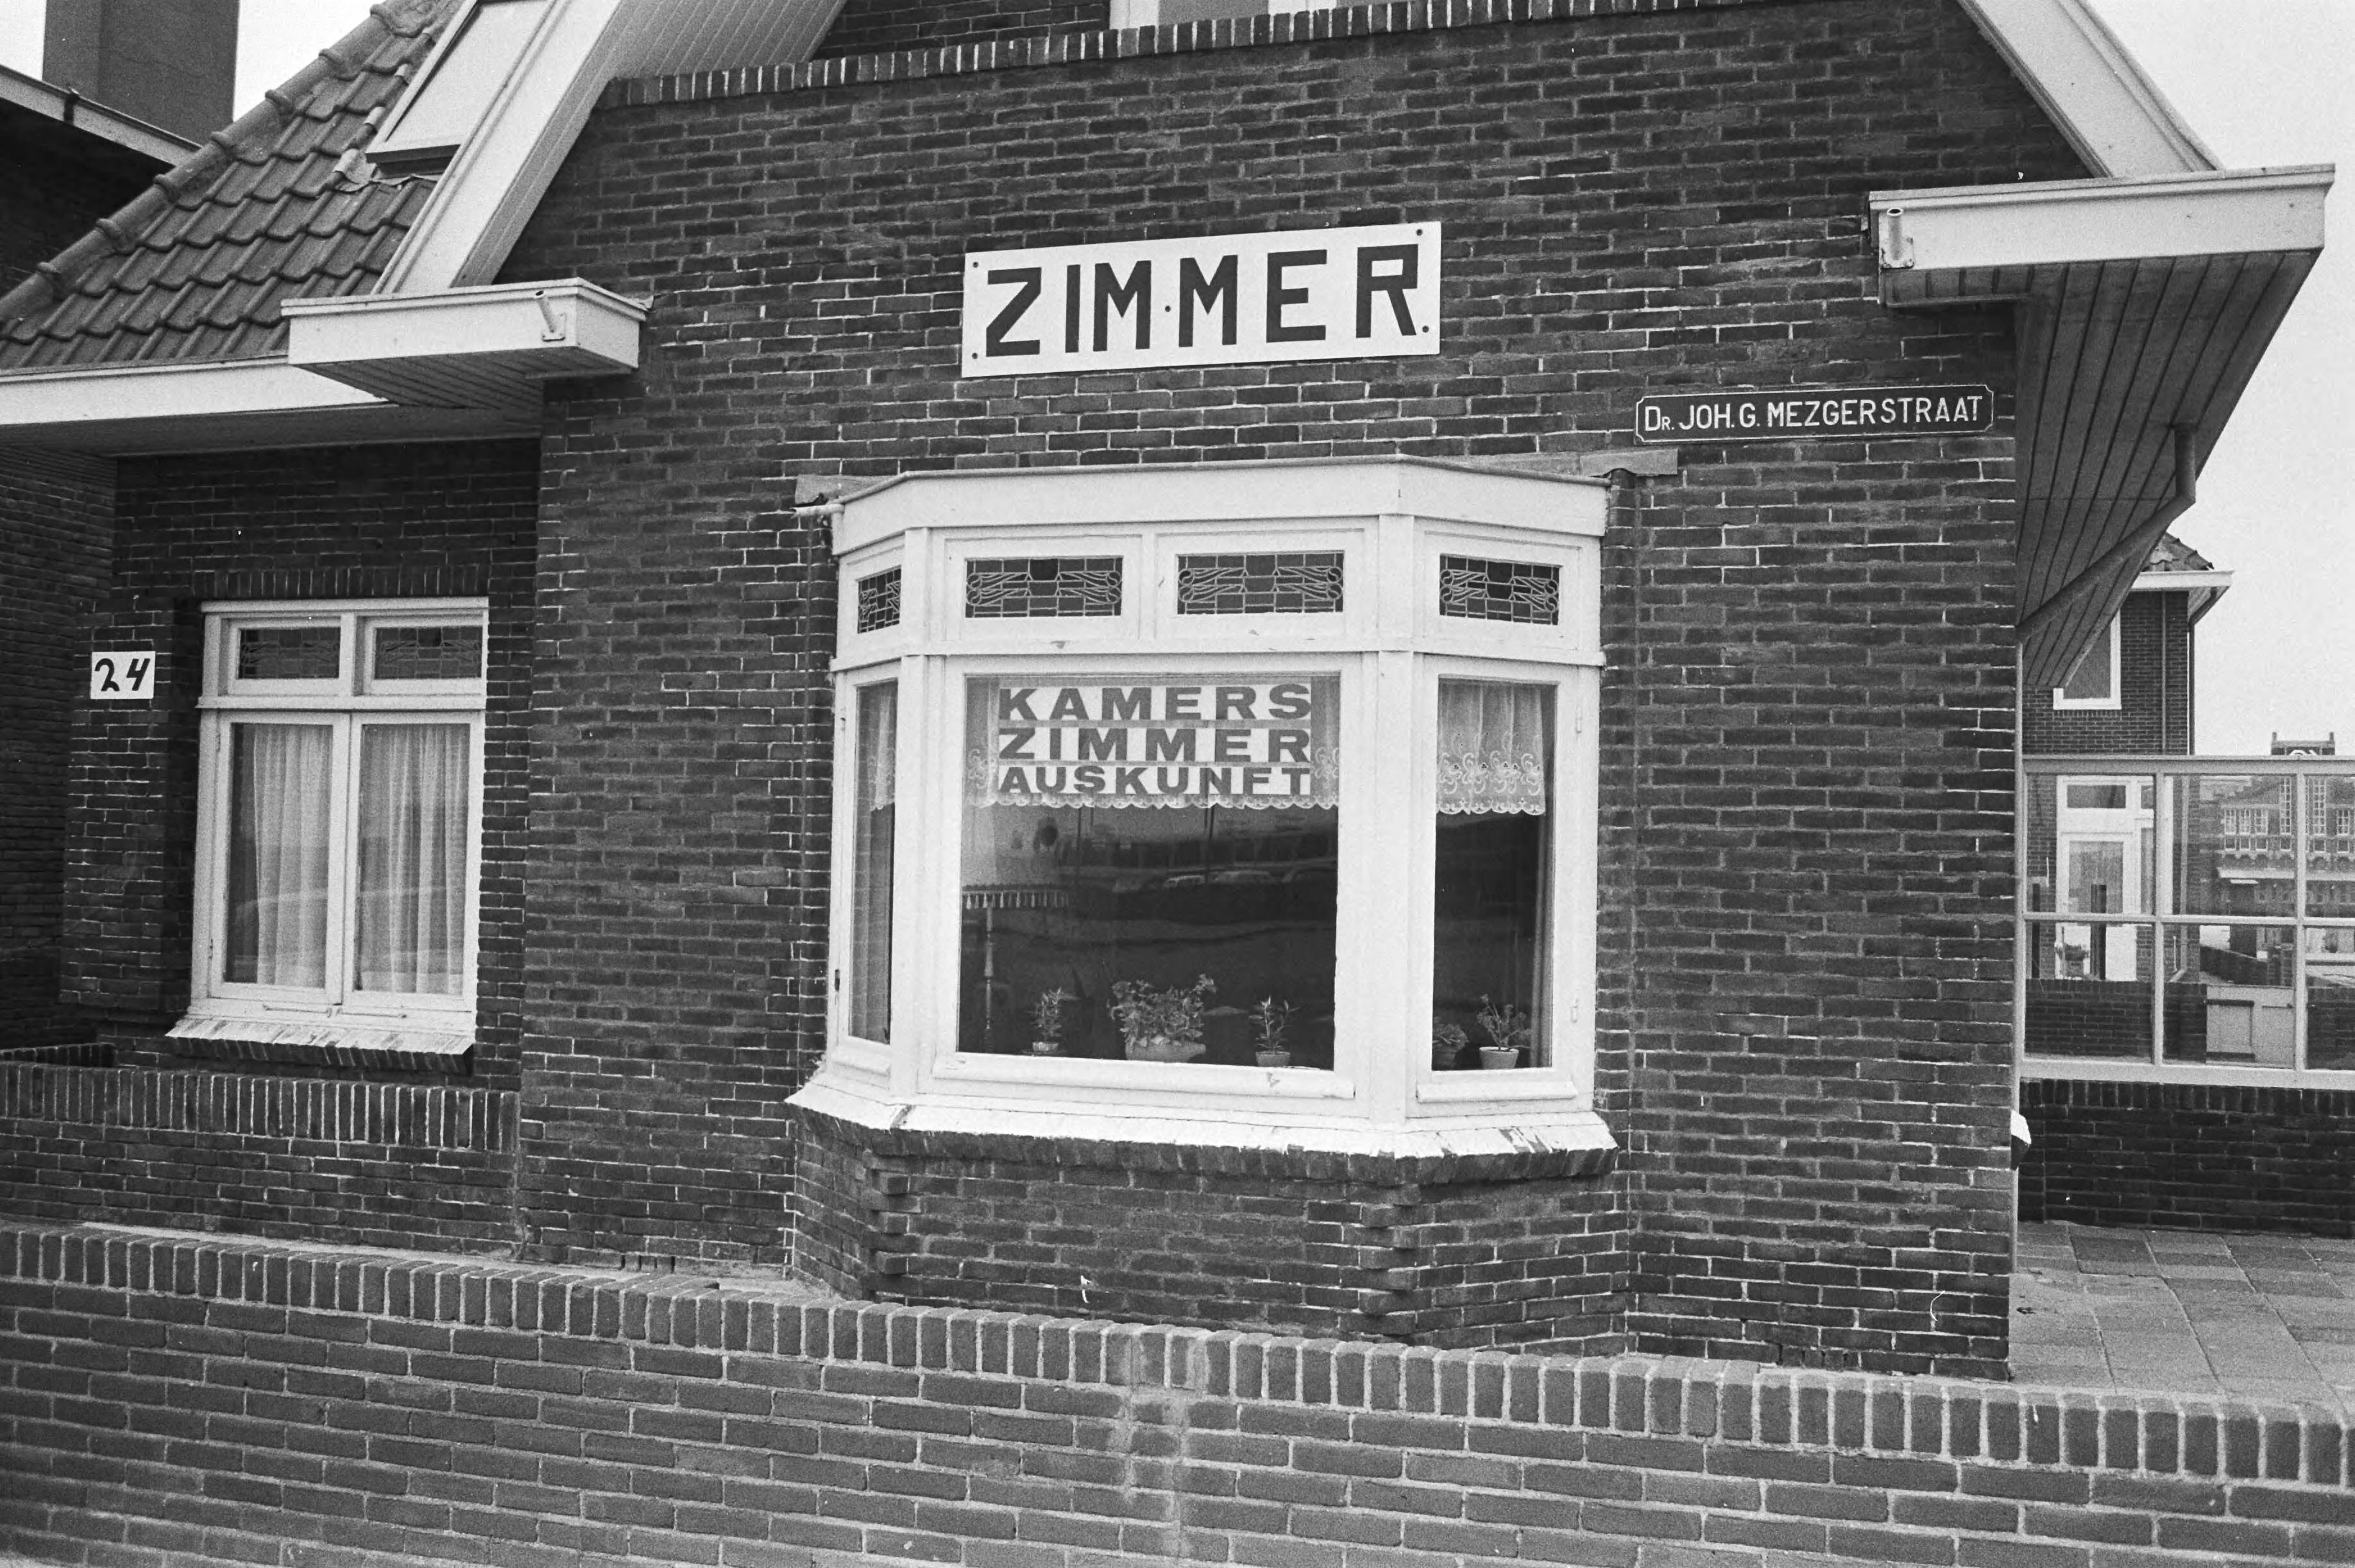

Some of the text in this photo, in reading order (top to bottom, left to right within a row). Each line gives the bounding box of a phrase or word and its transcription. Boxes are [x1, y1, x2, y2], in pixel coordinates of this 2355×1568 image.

[985, 243, 1419, 357] ZIMMER
[1767, 395, 1984, 428] MEZGERSTRAAT
[94, 658, 151, 692] 24
[998, 683, 1312, 721] KAMERS
[998, 728, 1311, 763] ZIMMER
[999, 765, 1311, 796] AUSKUNFT
